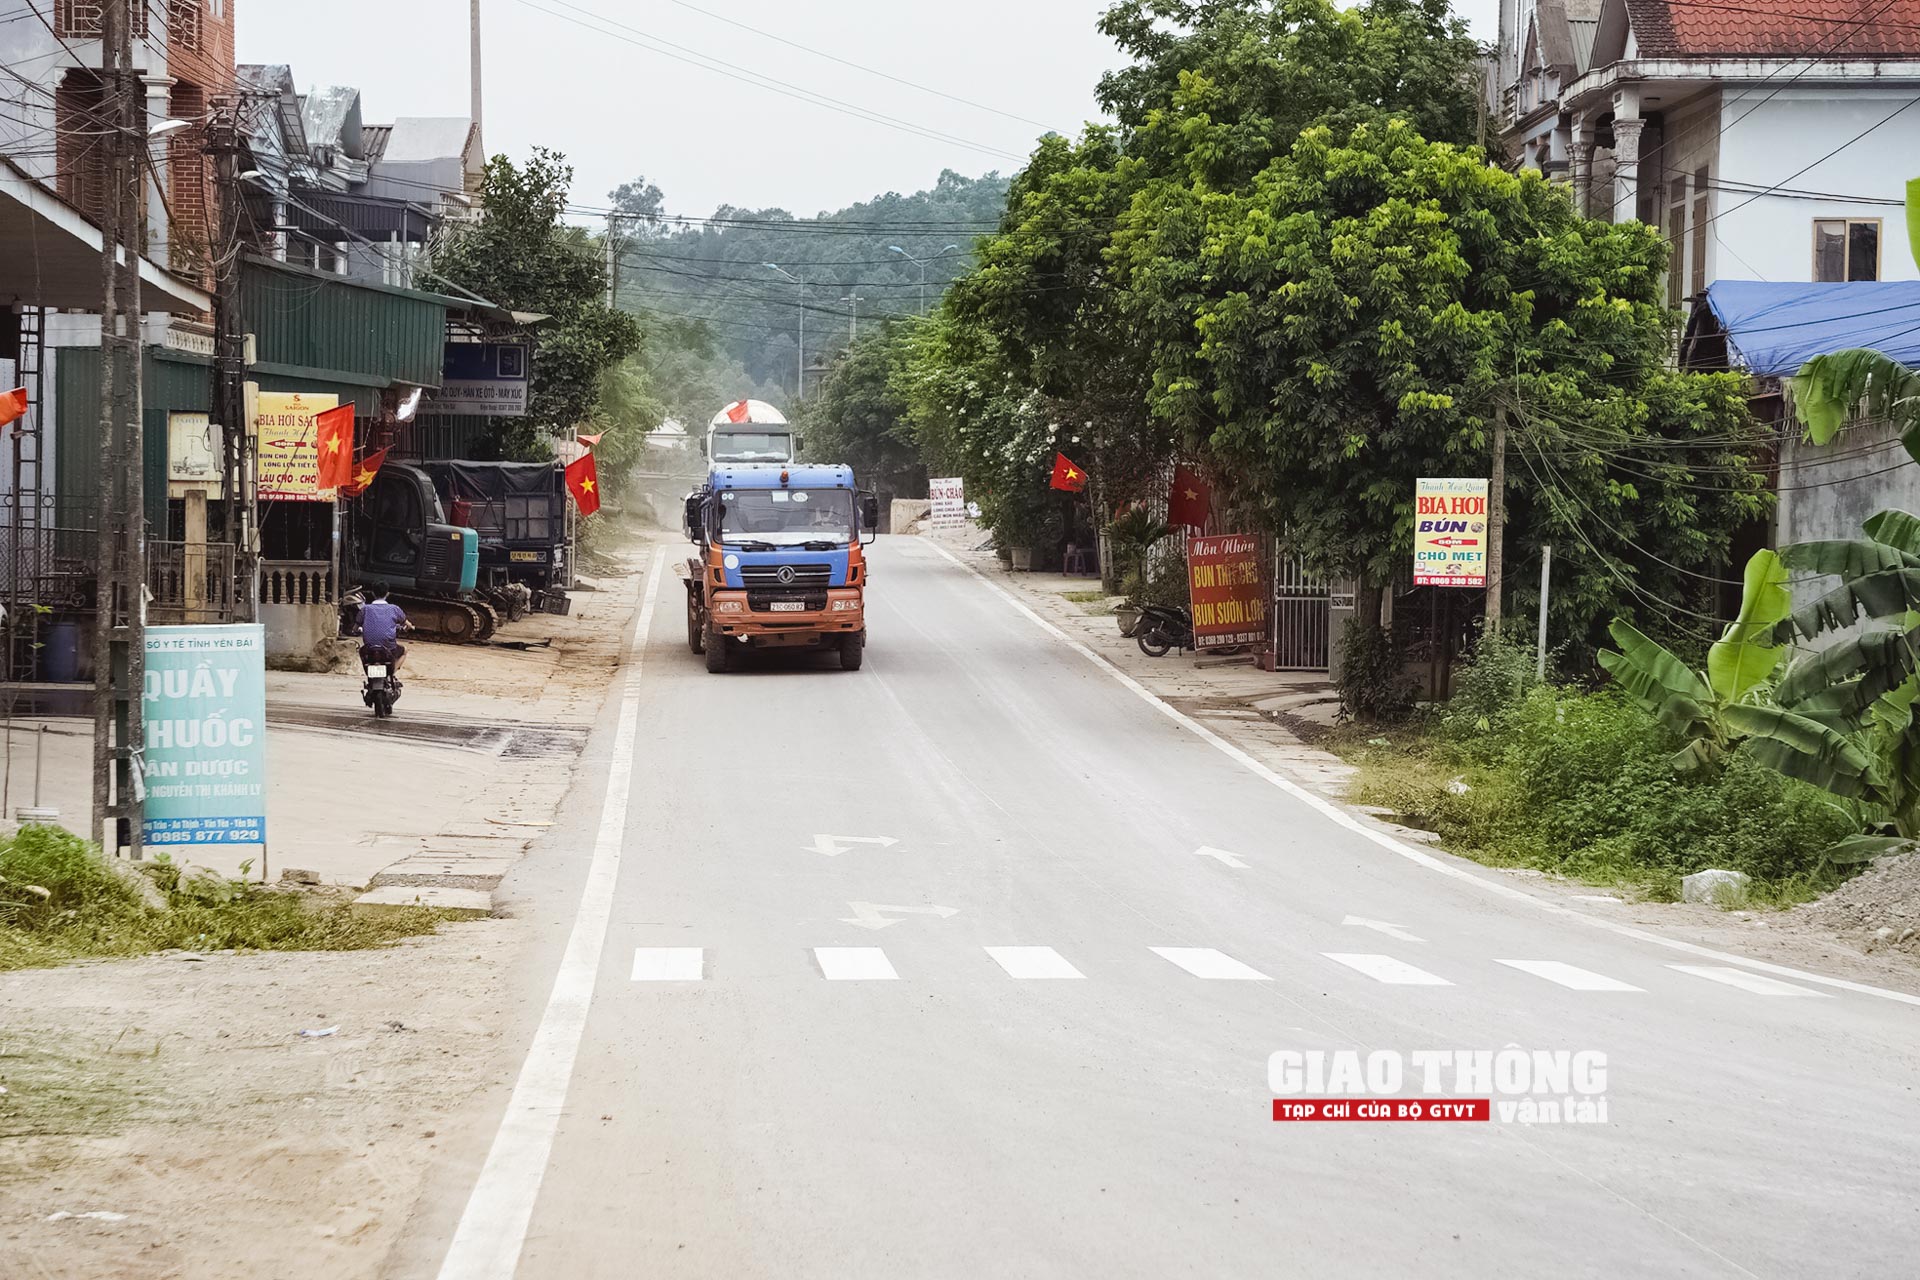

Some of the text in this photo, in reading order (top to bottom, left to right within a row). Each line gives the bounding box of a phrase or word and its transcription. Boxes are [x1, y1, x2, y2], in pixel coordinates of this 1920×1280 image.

[511, 385, 522, 399] XÚC
[259, 414, 275, 426] BIA
[278, 413, 295, 426] HƠI
[1420, 482, 1444, 490] Thanh
[1418, 496, 1486, 514] BIA HƠI
[1418, 518, 1468, 532] BÚN
[1190, 541, 1216, 556] Môn
[1418, 550, 1483, 563] CHÓ MẸT
[1194, 560, 1214, 588] BÚN
[1194, 599, 1216, 626] BÚN
[1217, 596, 1244, 624] SƯỜN
[147, 636, 252, 648] SỞ Y TẾ TỈNH YÊN BÁI
[144, 659, 240, 702] QUẦY
[143, 708, 254, 748] HUỐC
[144, 760, 248, 778] ÂN DƯỢC
[195, 784, 211, 799] THỊ
[214, 781, 249, 796] KHÁNH
[250, 784, 261, 796] LY
[152, 830, 260, 842] 0985 877 929
